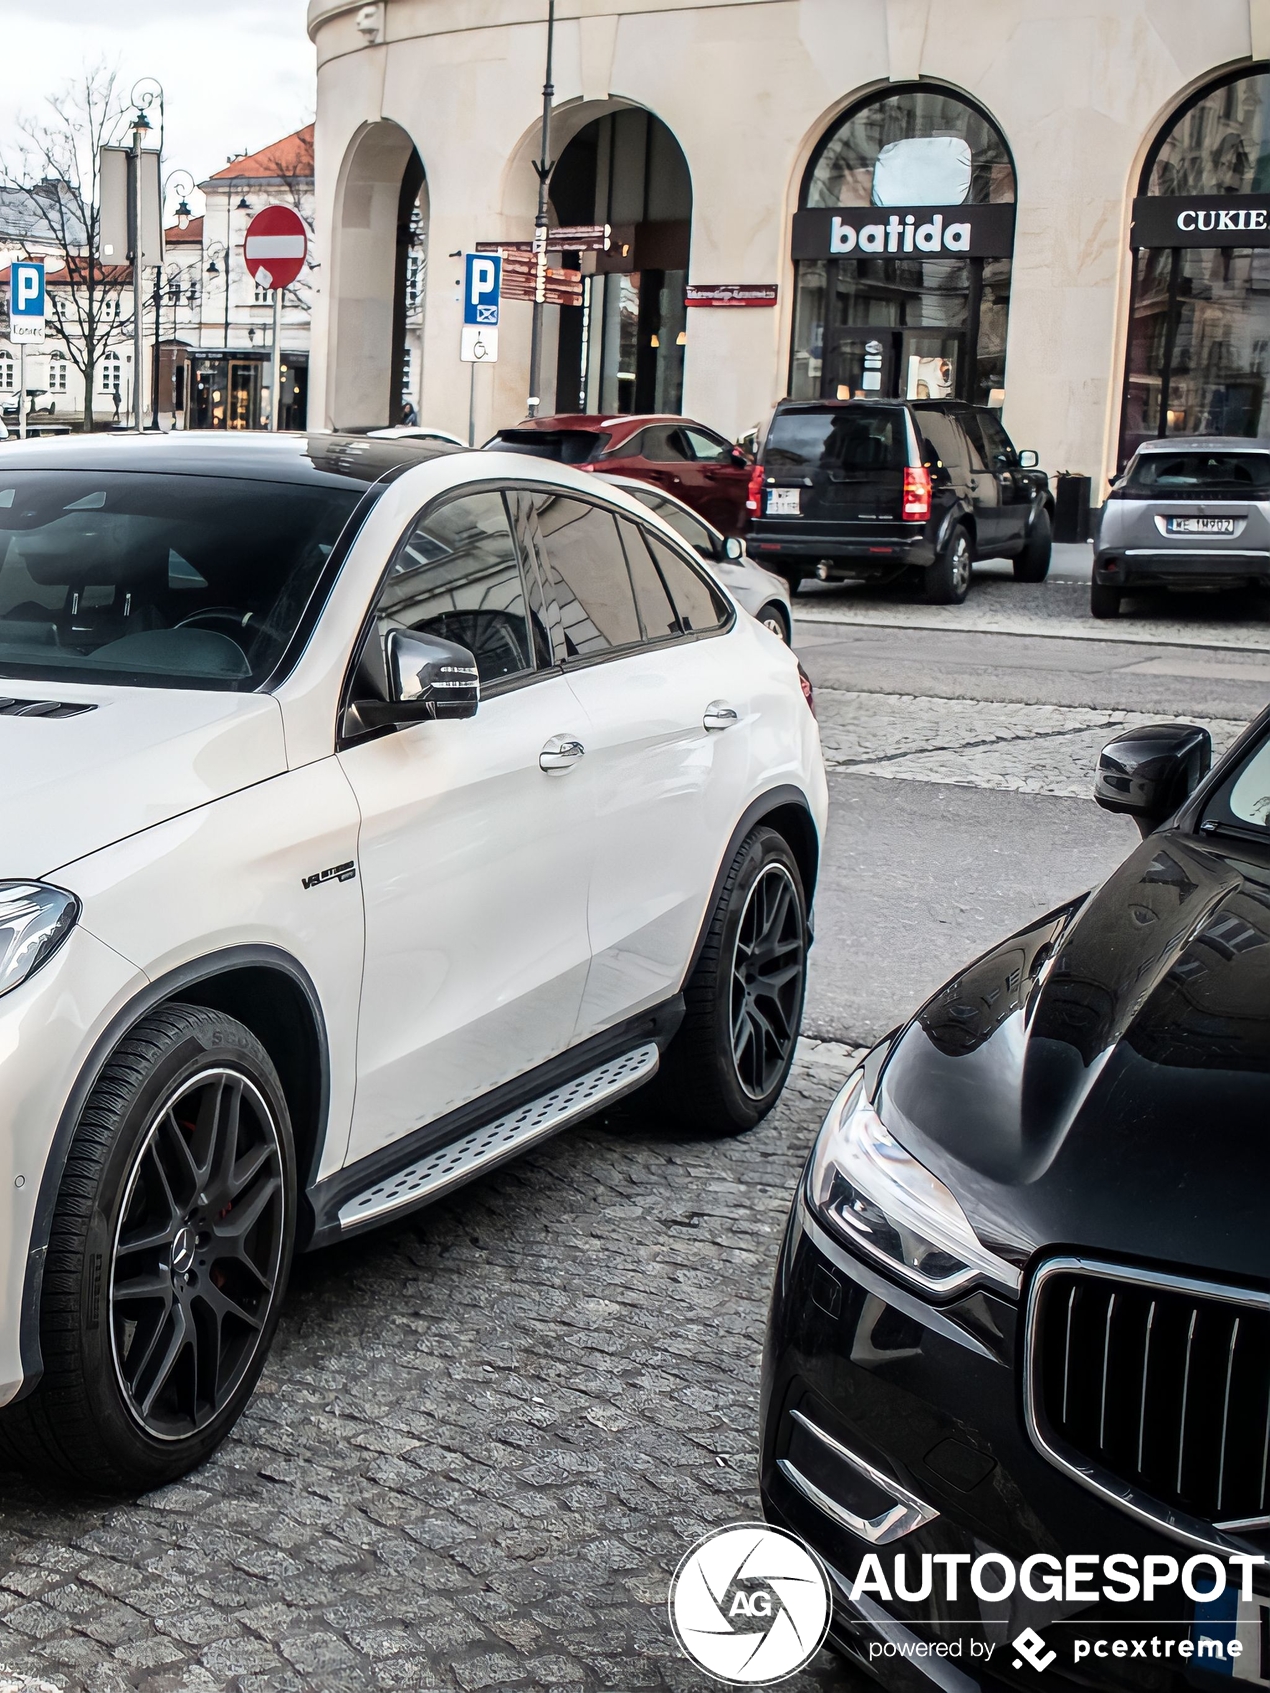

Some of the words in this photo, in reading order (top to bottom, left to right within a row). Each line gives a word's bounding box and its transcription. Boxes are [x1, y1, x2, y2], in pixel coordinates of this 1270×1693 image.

[830, 214, 972, 253] batida
[1177, 210, 1270, 231] CUKIE
[18, 267, 39, 311] P
[471, 258, 495, 305] P
